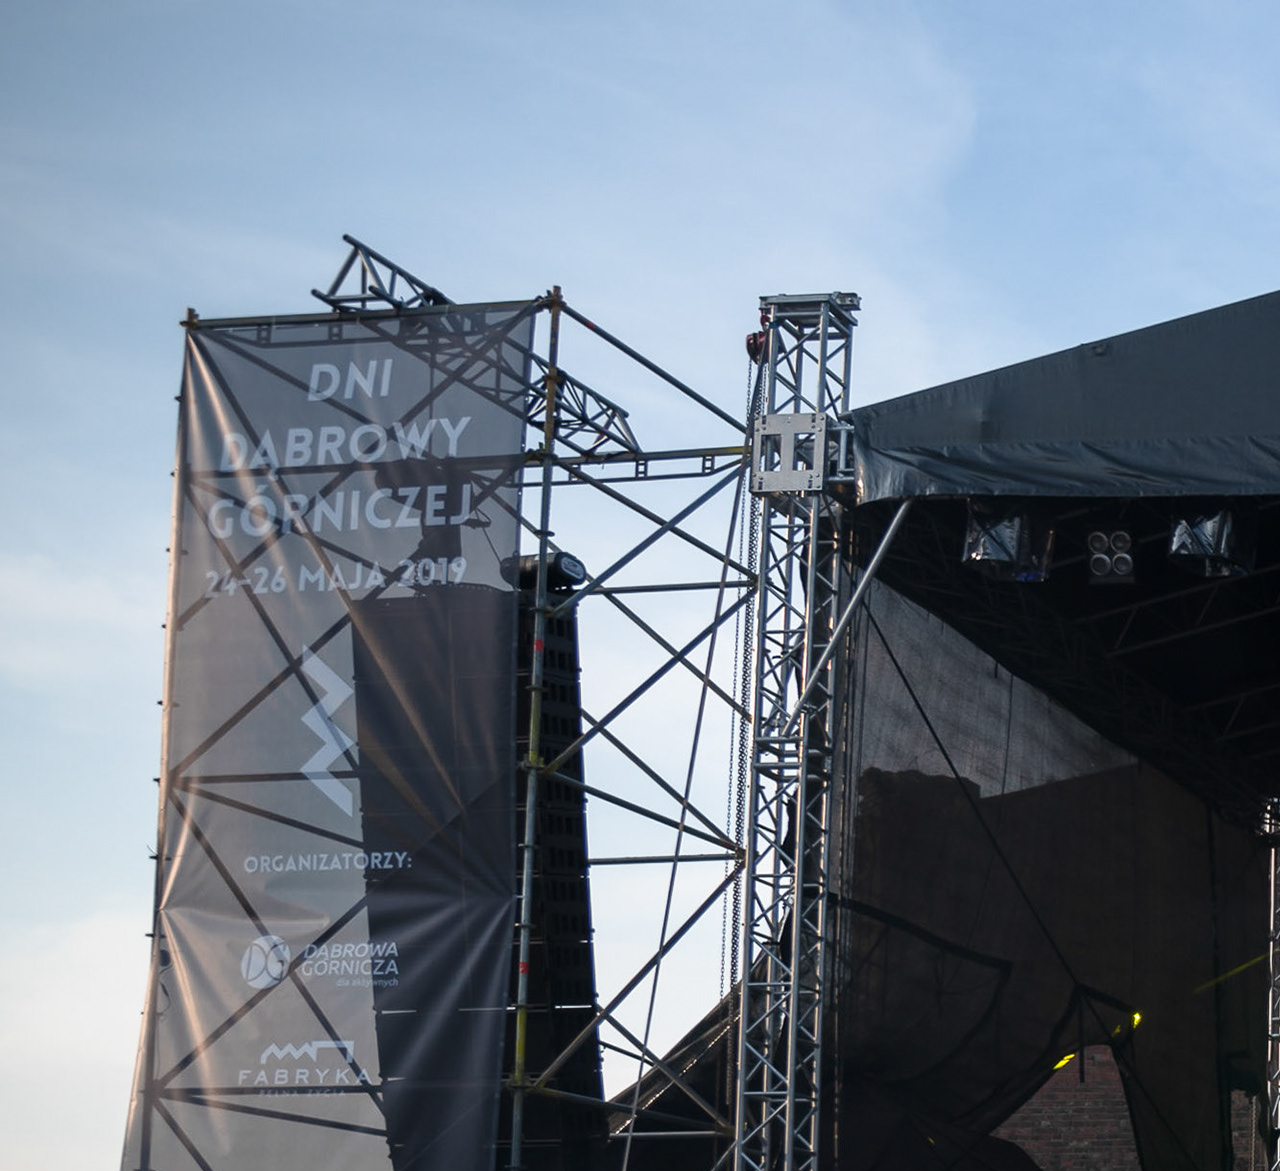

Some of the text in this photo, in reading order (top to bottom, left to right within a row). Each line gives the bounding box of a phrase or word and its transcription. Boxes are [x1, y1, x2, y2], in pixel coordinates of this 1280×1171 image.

[306, 358, 394, 402] DNI
[219, 416, 473, 481] DĄBROWY
[206, 482, 474, 540] GÓRNICZEJ
[204, 556, 468, 599] 24-26 MAJA 2019
[243, 851, 413, 873] ORGANIZATORZY:
[301, 957, 400, 977] GÓRNICZA
[303, 941, 400, 962] DĄBROWA
[238, 1068, 374, 1086] FABRYKA
